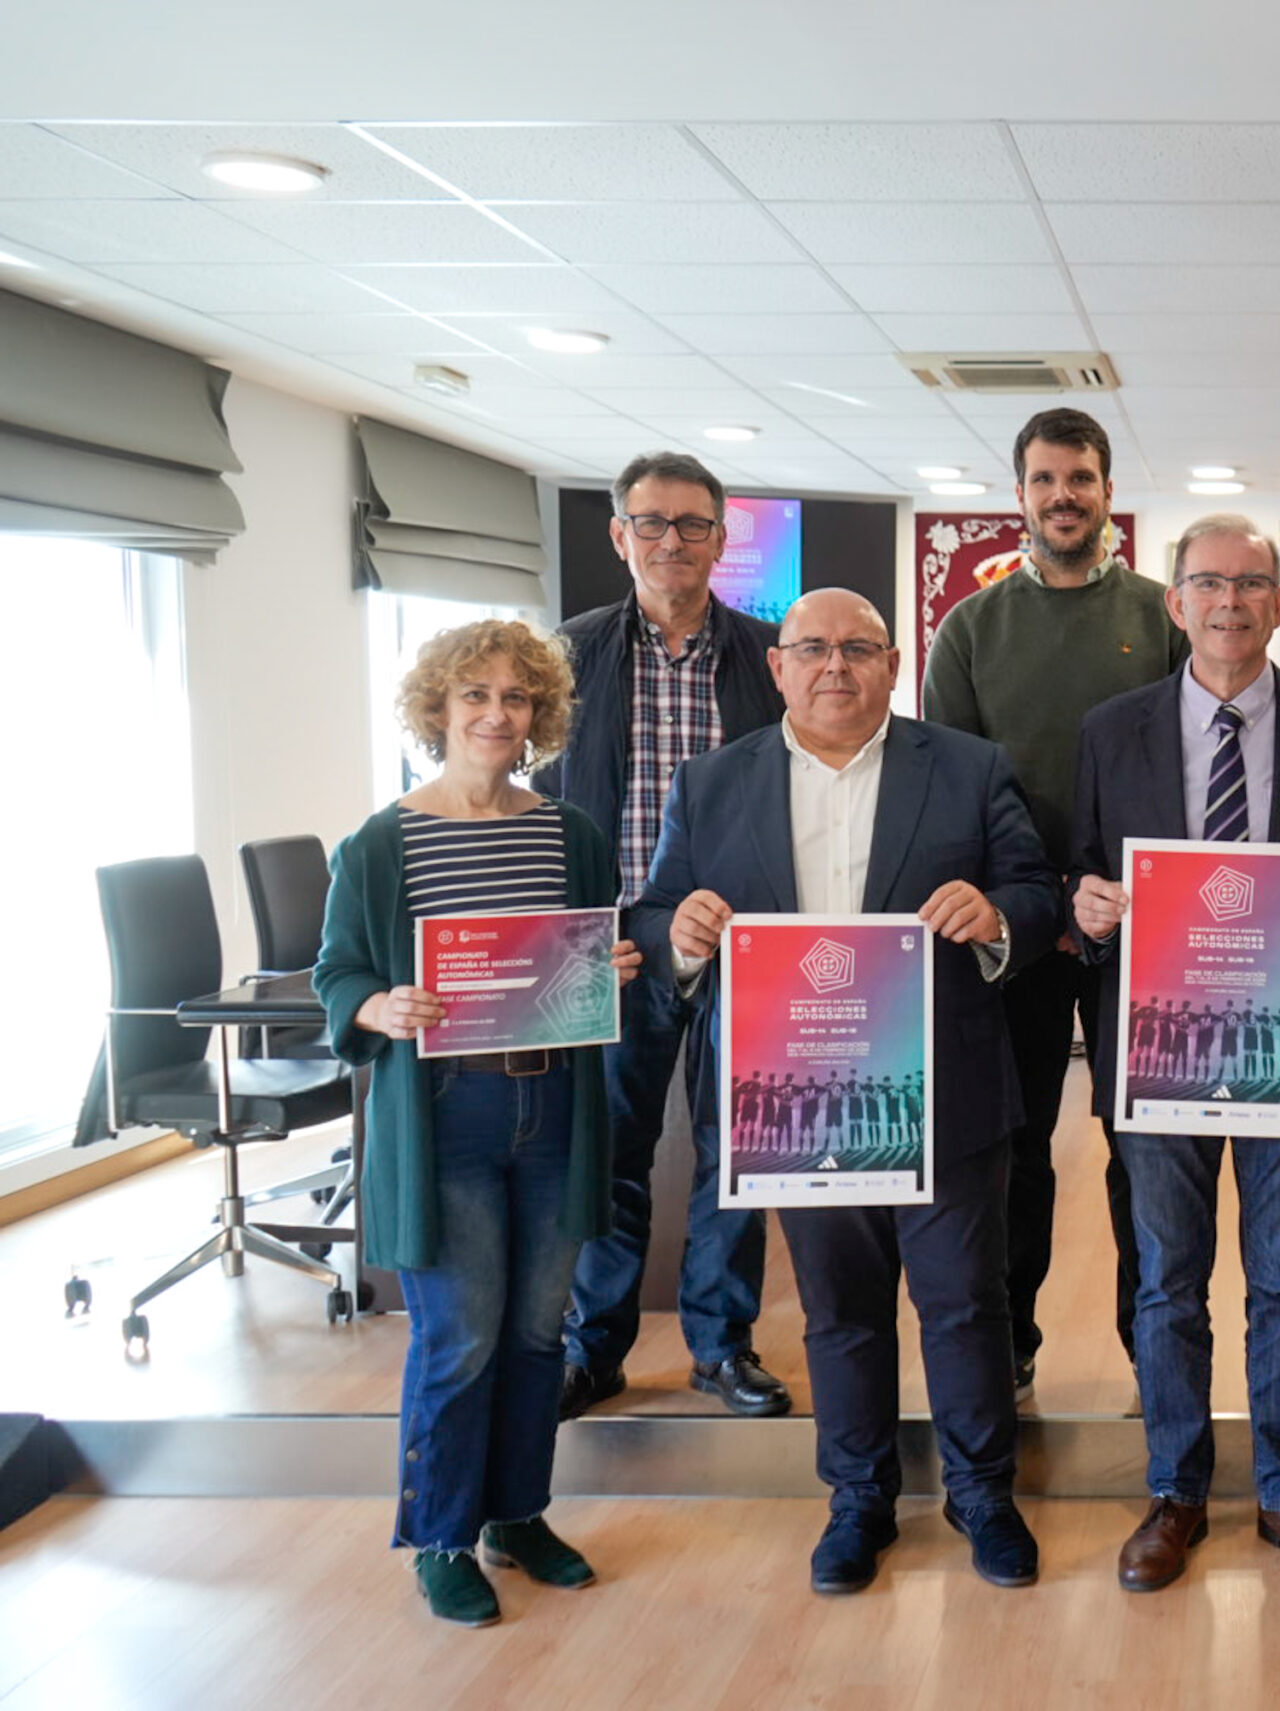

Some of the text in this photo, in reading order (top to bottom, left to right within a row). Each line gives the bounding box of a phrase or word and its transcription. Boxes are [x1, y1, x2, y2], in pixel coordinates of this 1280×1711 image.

[1188, 934, 1264, 943] SELECCIONES
[436, 951, 489, 961] CAMPIONATO
[436, 962, 447, 970] DE
[449, 960, 478, 969] ESPAÑA
[480, 960, 489, 968] DE
[436, 970, 495, 979] AUTONÓMICAS
